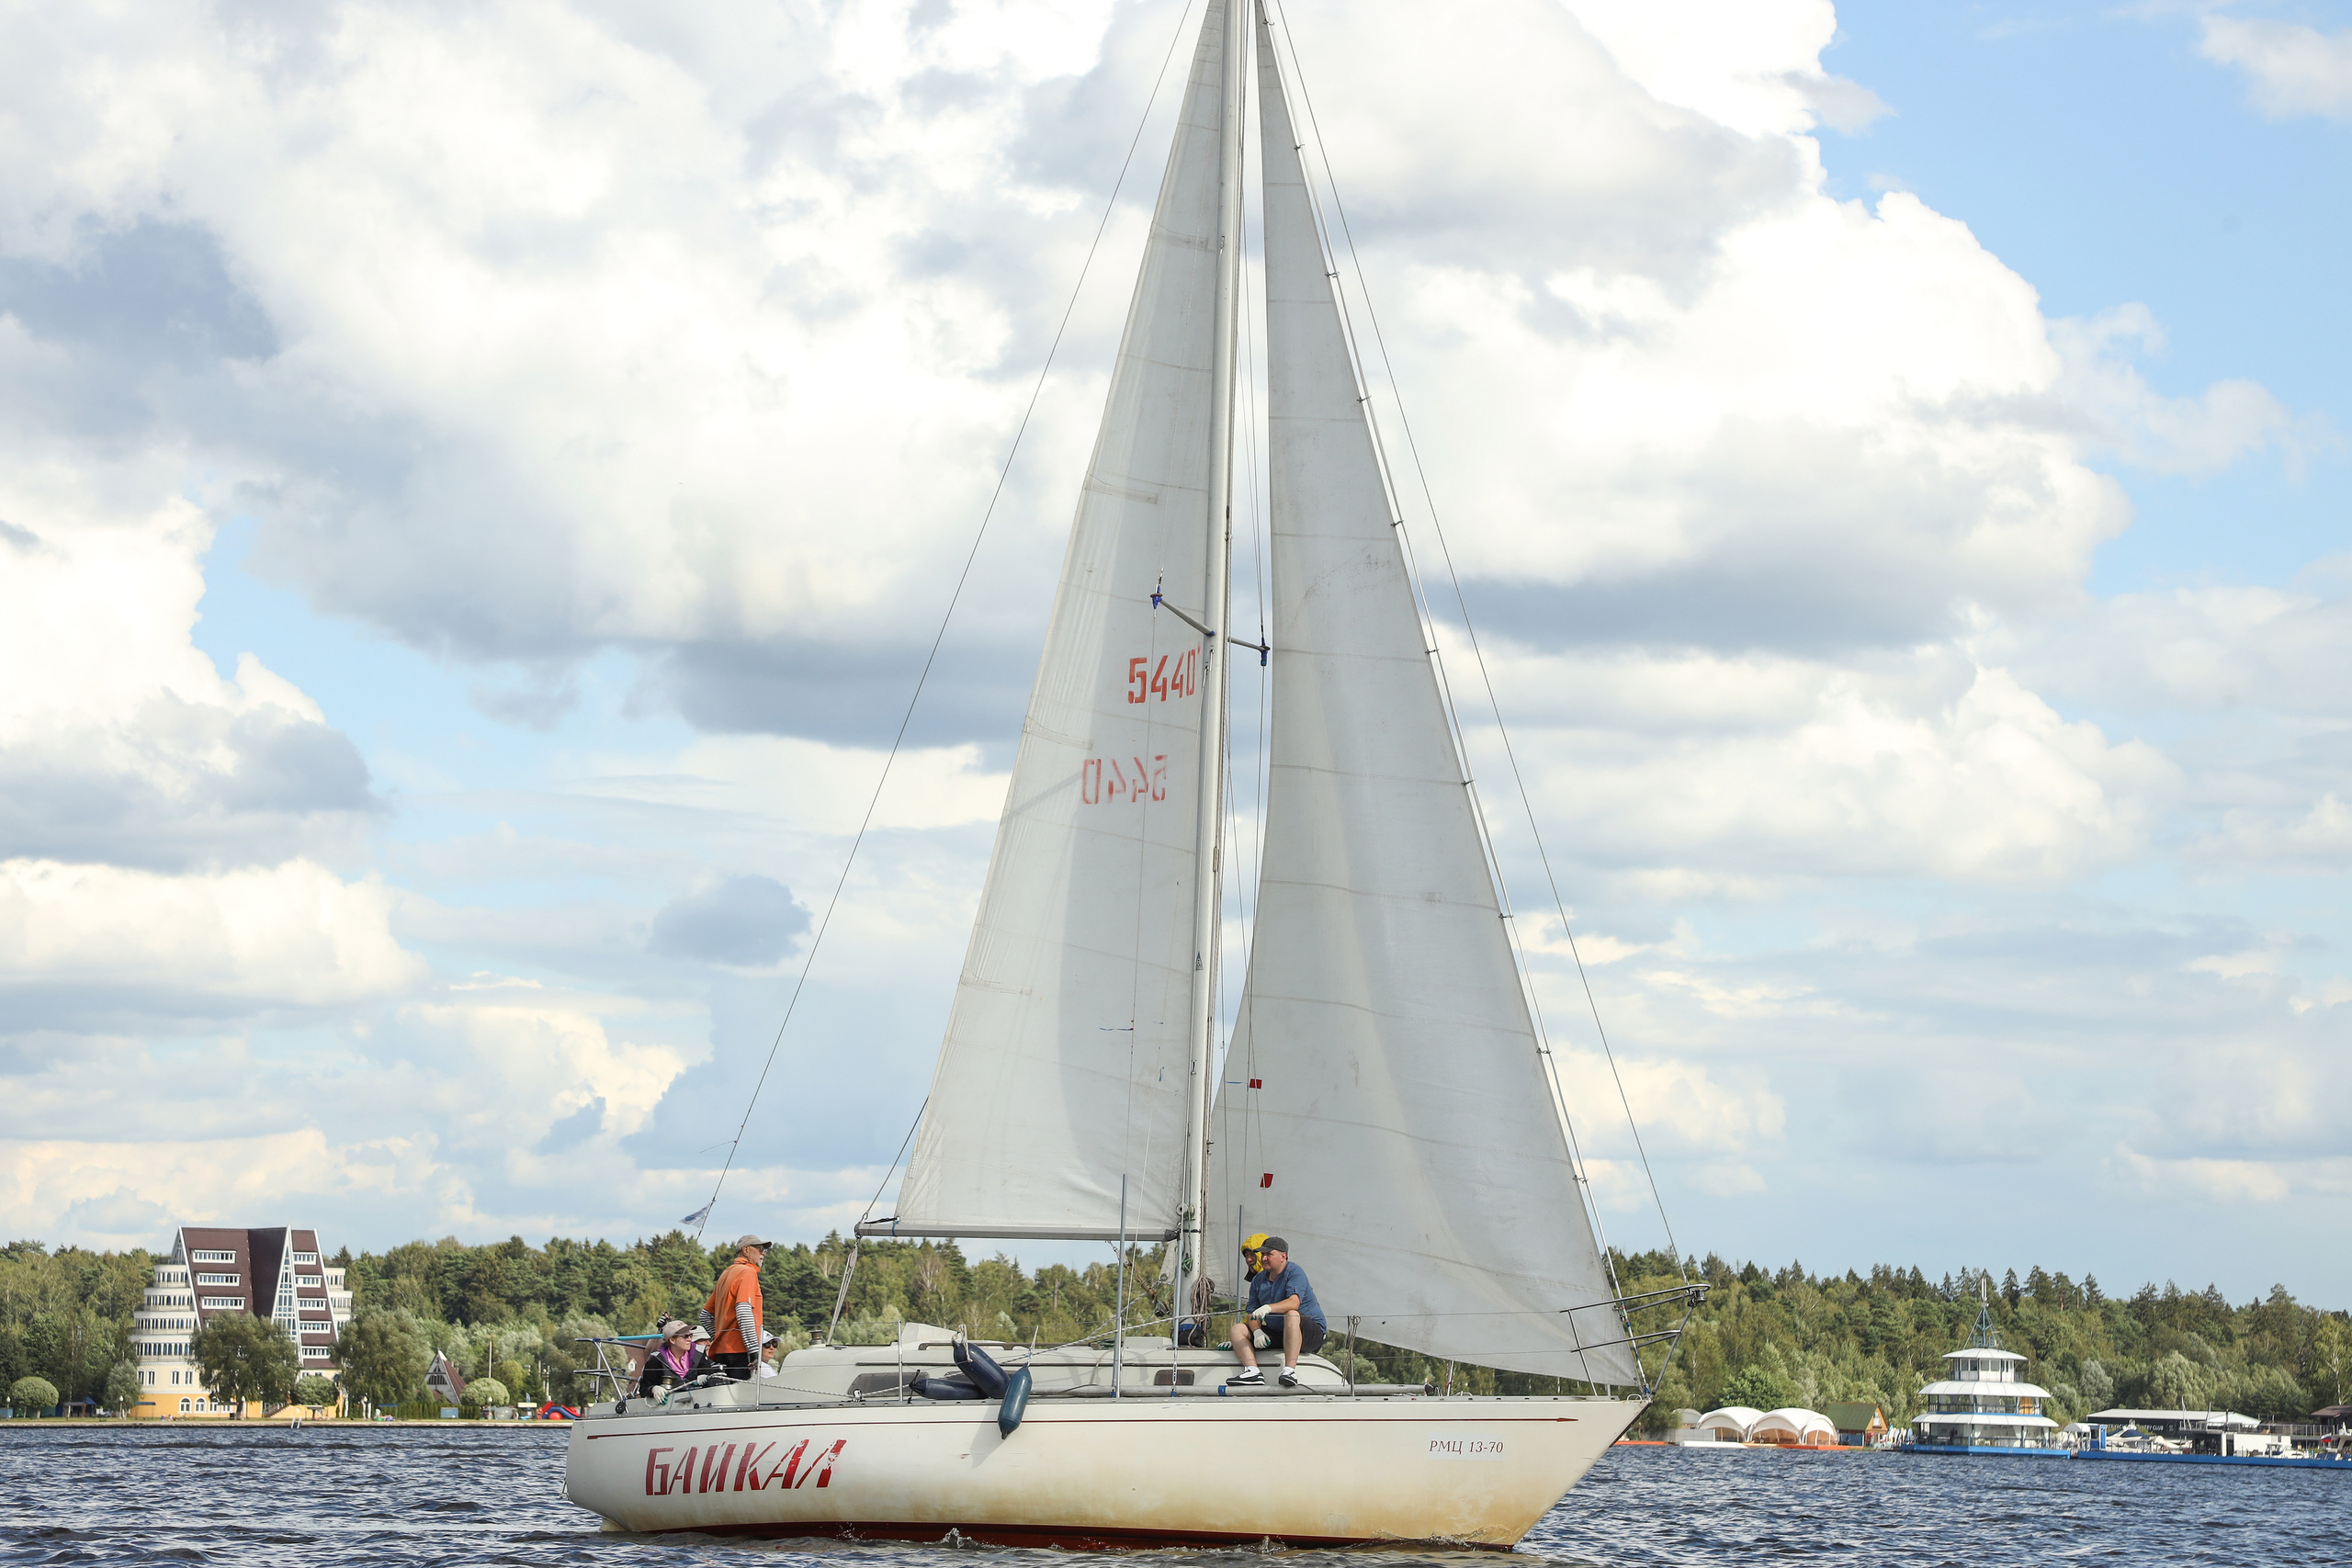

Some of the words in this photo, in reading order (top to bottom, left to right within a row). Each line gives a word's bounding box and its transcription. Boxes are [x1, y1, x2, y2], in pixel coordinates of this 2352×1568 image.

[1128, 649, 1195, 704] 5440
[1429, 1440, 1463, 1455] РМЦ
[1469, 1441, 1504, 1453] 13-70
